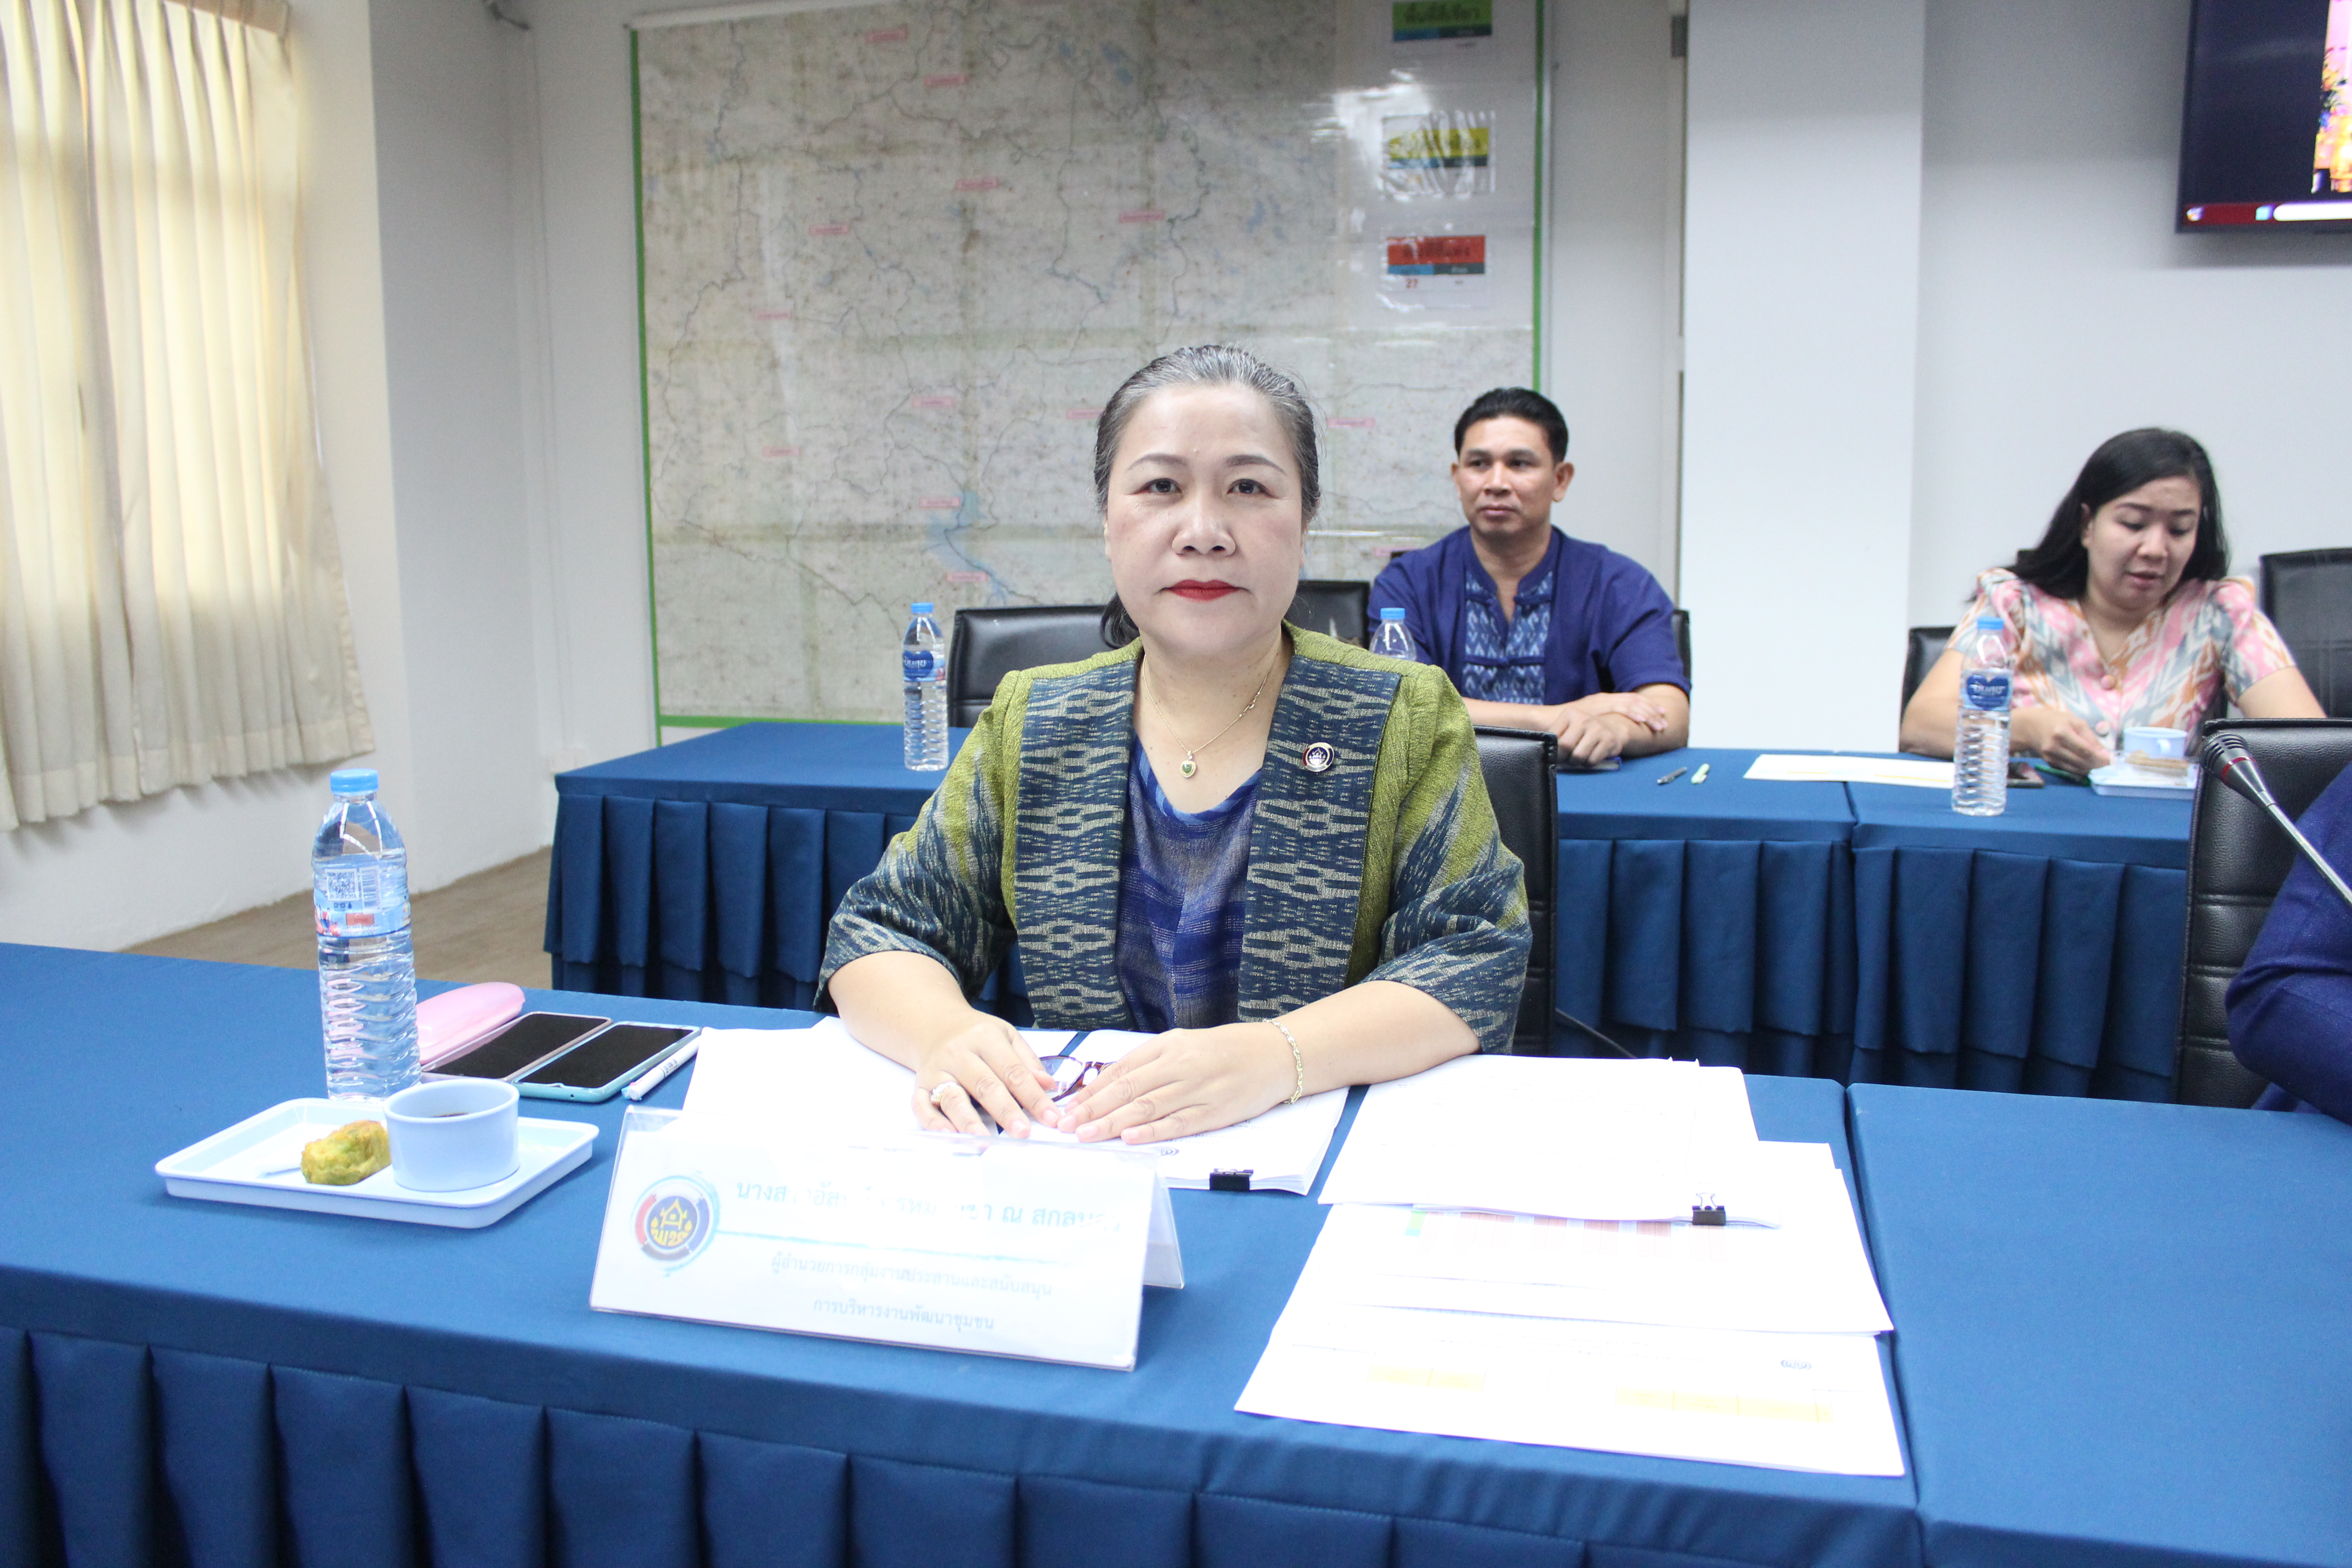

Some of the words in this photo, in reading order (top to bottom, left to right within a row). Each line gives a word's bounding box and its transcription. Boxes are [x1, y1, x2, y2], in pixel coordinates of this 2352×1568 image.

[1002, 1205, 1023, 1224] ณ
[813, 1298, 994, 1333] การบริหารงานพัฒนาชุมชน
